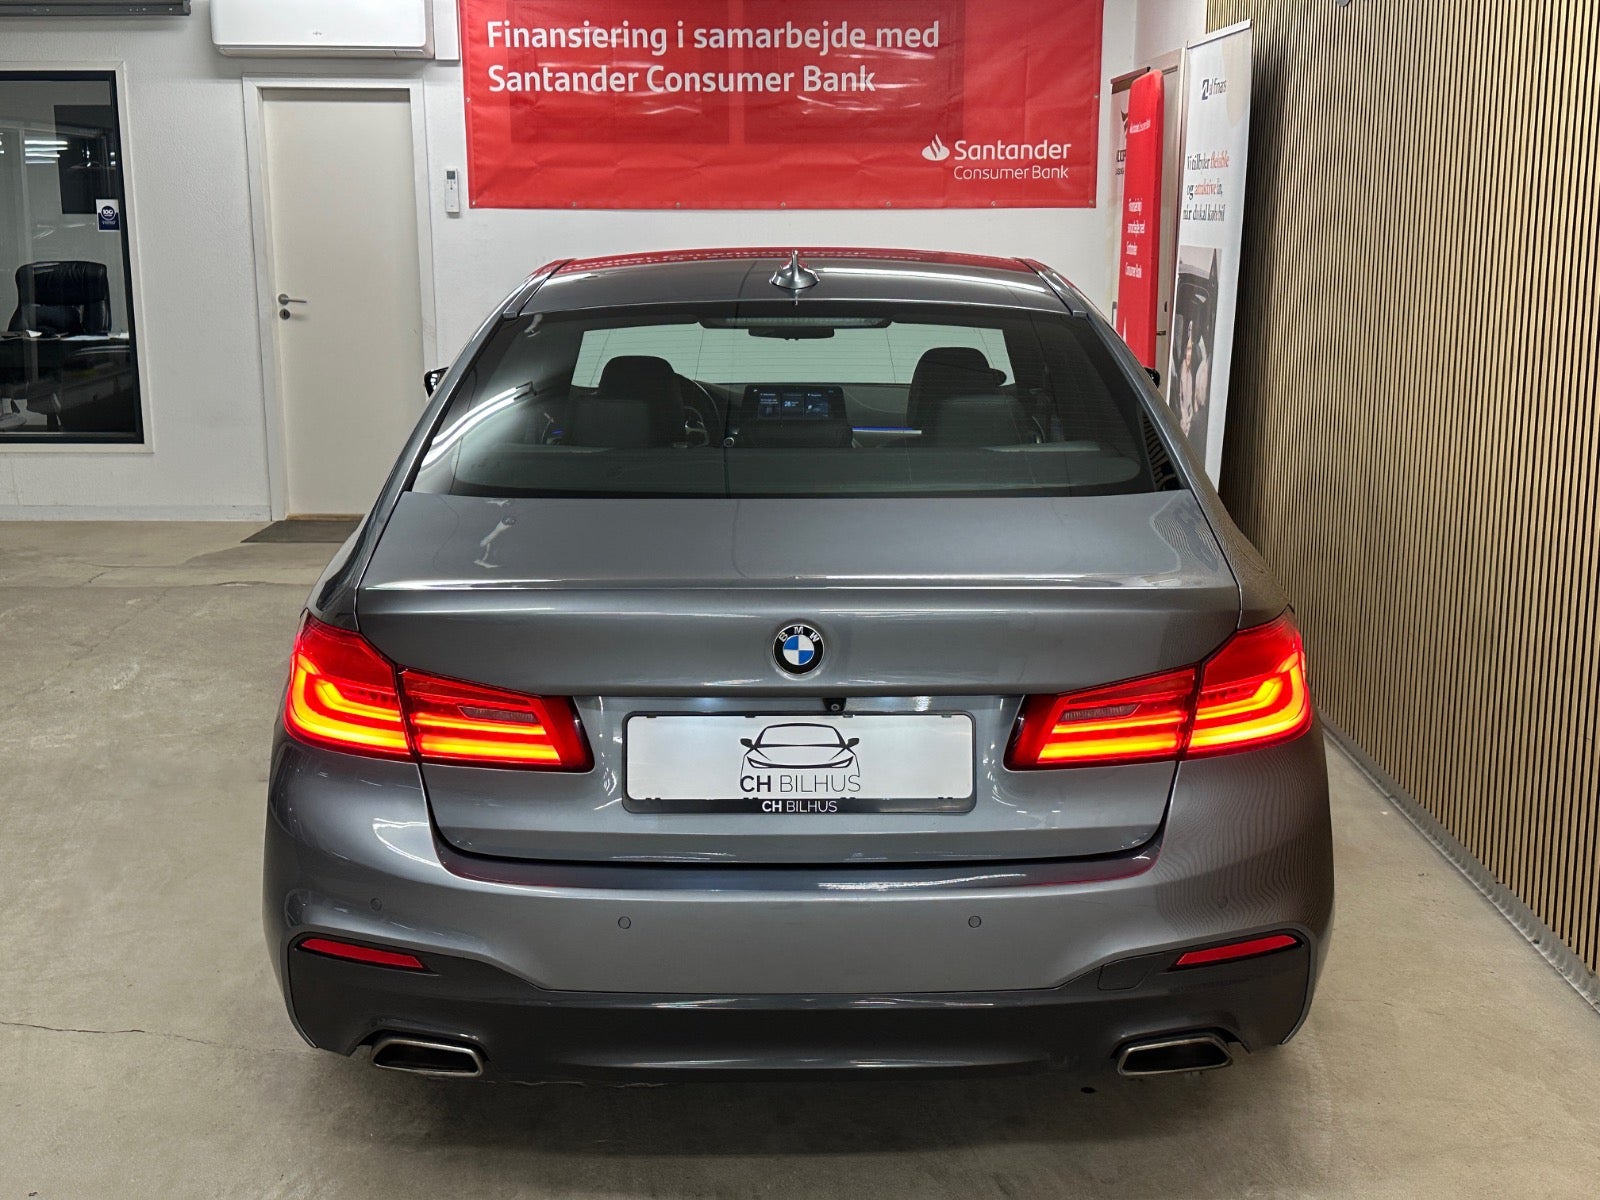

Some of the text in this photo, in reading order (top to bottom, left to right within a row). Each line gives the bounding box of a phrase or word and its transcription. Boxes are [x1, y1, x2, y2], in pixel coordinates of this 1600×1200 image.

[487, 20, 939, 56] Finansiering i samarbejde med
[488, 64, 876, 92] Santander Consumer Bank
[954, 139, 1072, 160] Santander
[954, 165, 1069, 180] Consumer Bank
[779, 626, 820, 642] BMW
[740, 774, 861, 792] CH BILHUS
[762, 800, 838, 812] CH BILHUS
